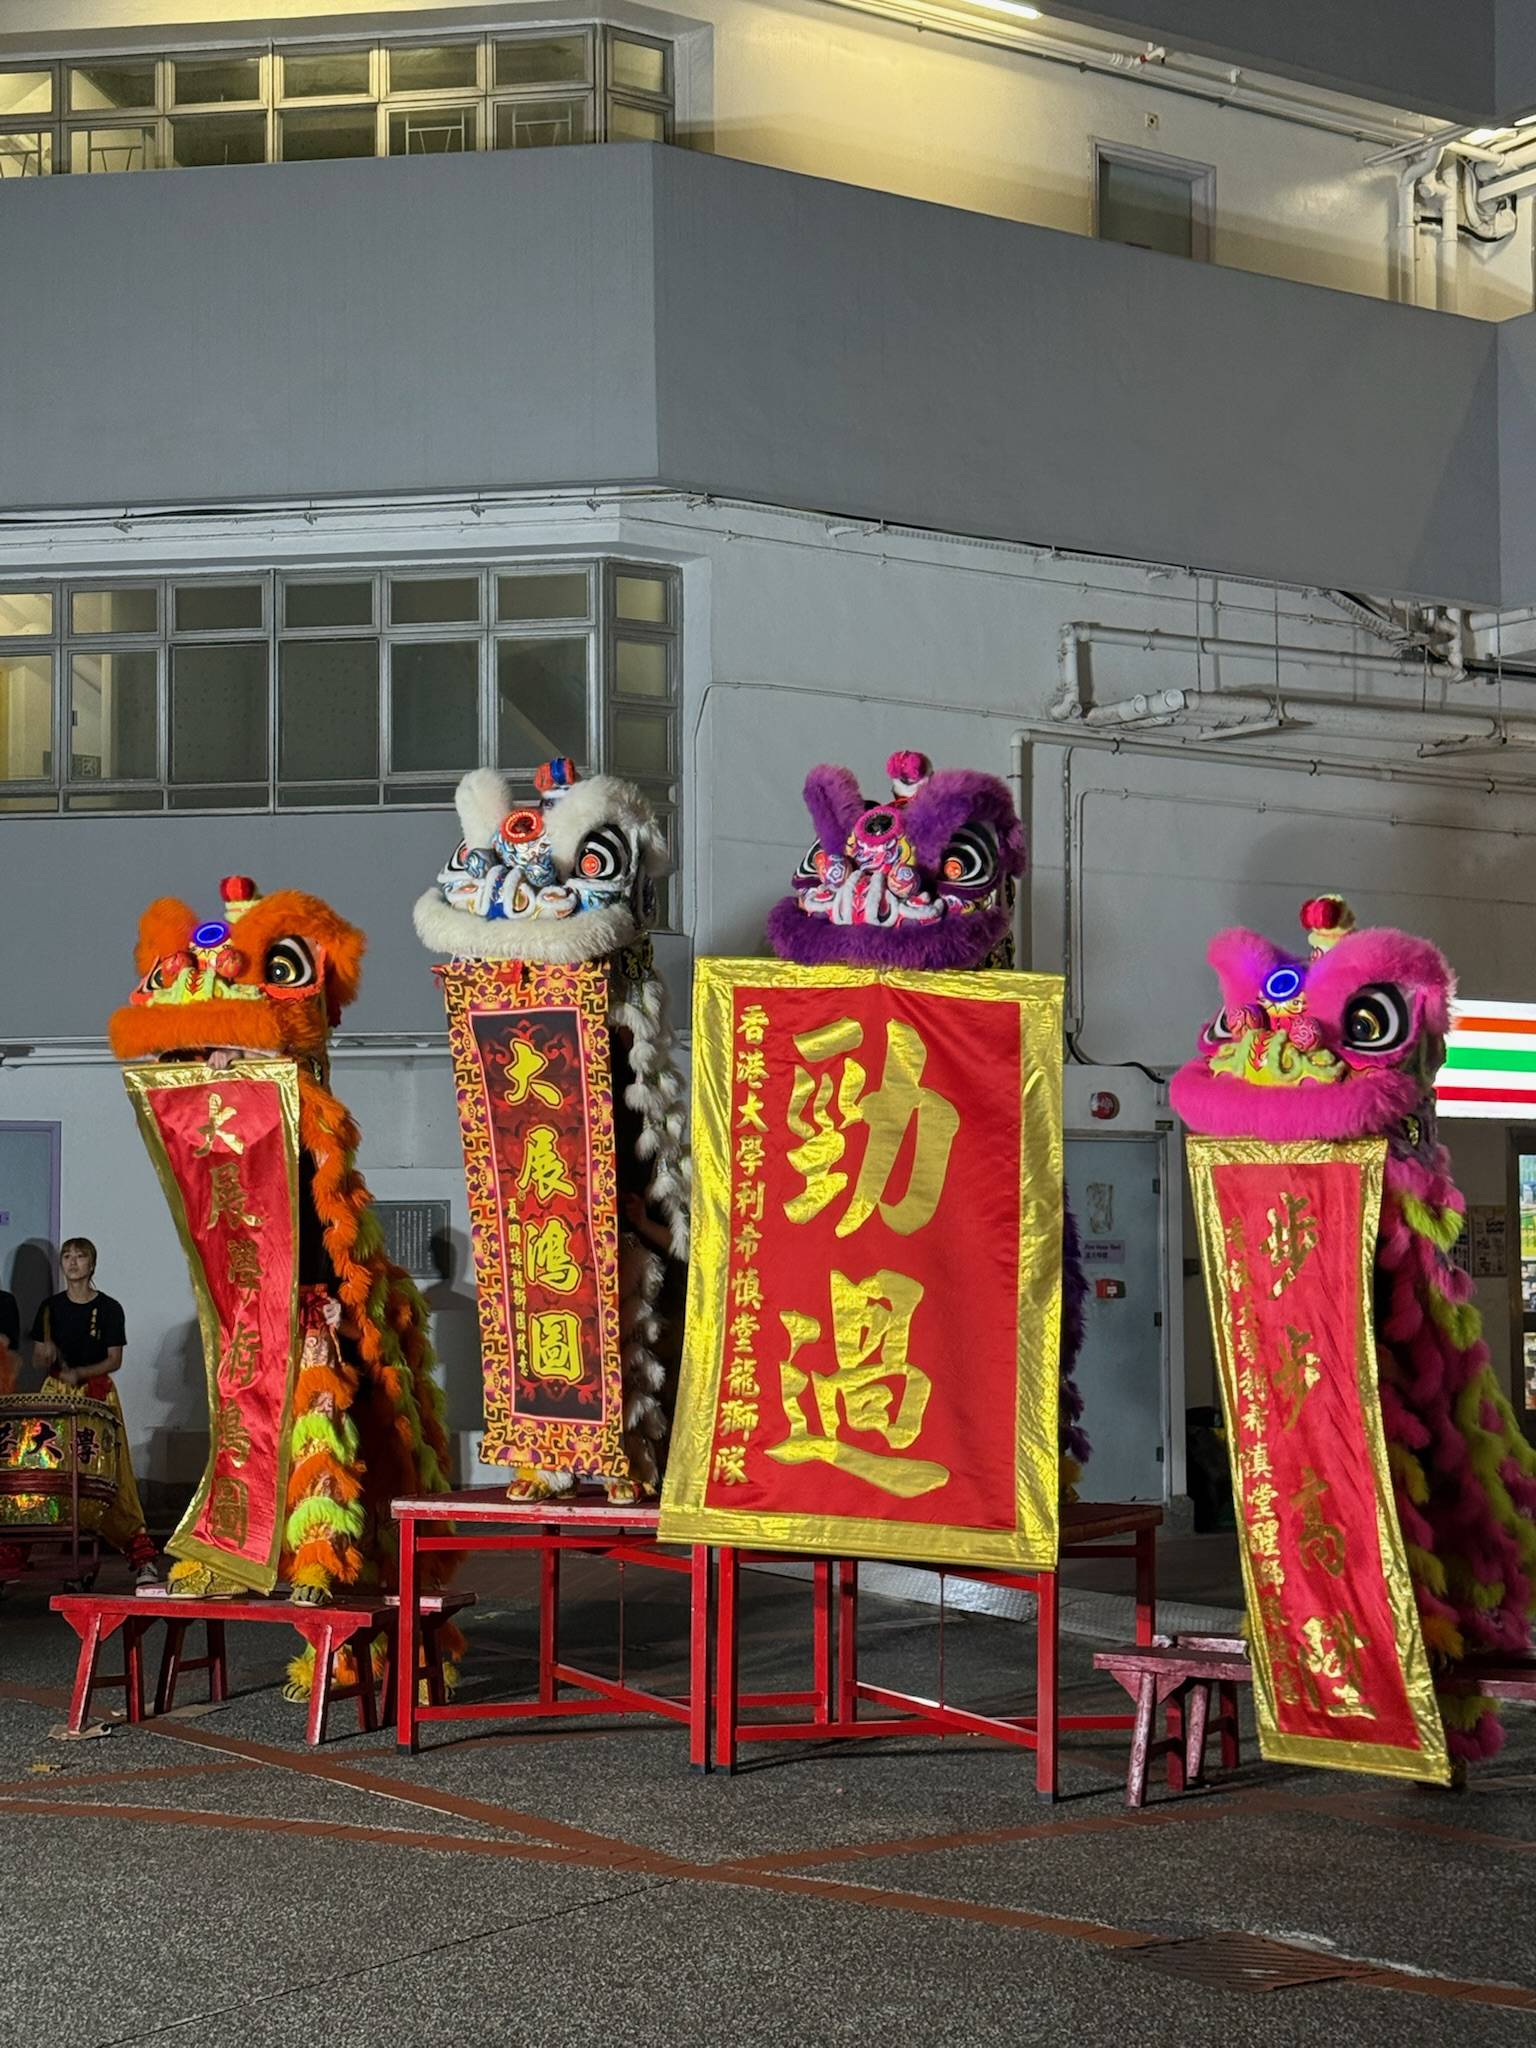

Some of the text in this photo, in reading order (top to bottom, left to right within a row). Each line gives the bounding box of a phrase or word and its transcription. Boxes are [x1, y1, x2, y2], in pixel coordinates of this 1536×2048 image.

[504, 1037, 585, 1383] 大展鴻圖
[712, 1003, 772, 1487] 香港大學利希慎堂龍獅隊
[764, 1016, 961, 1499] 勁過
